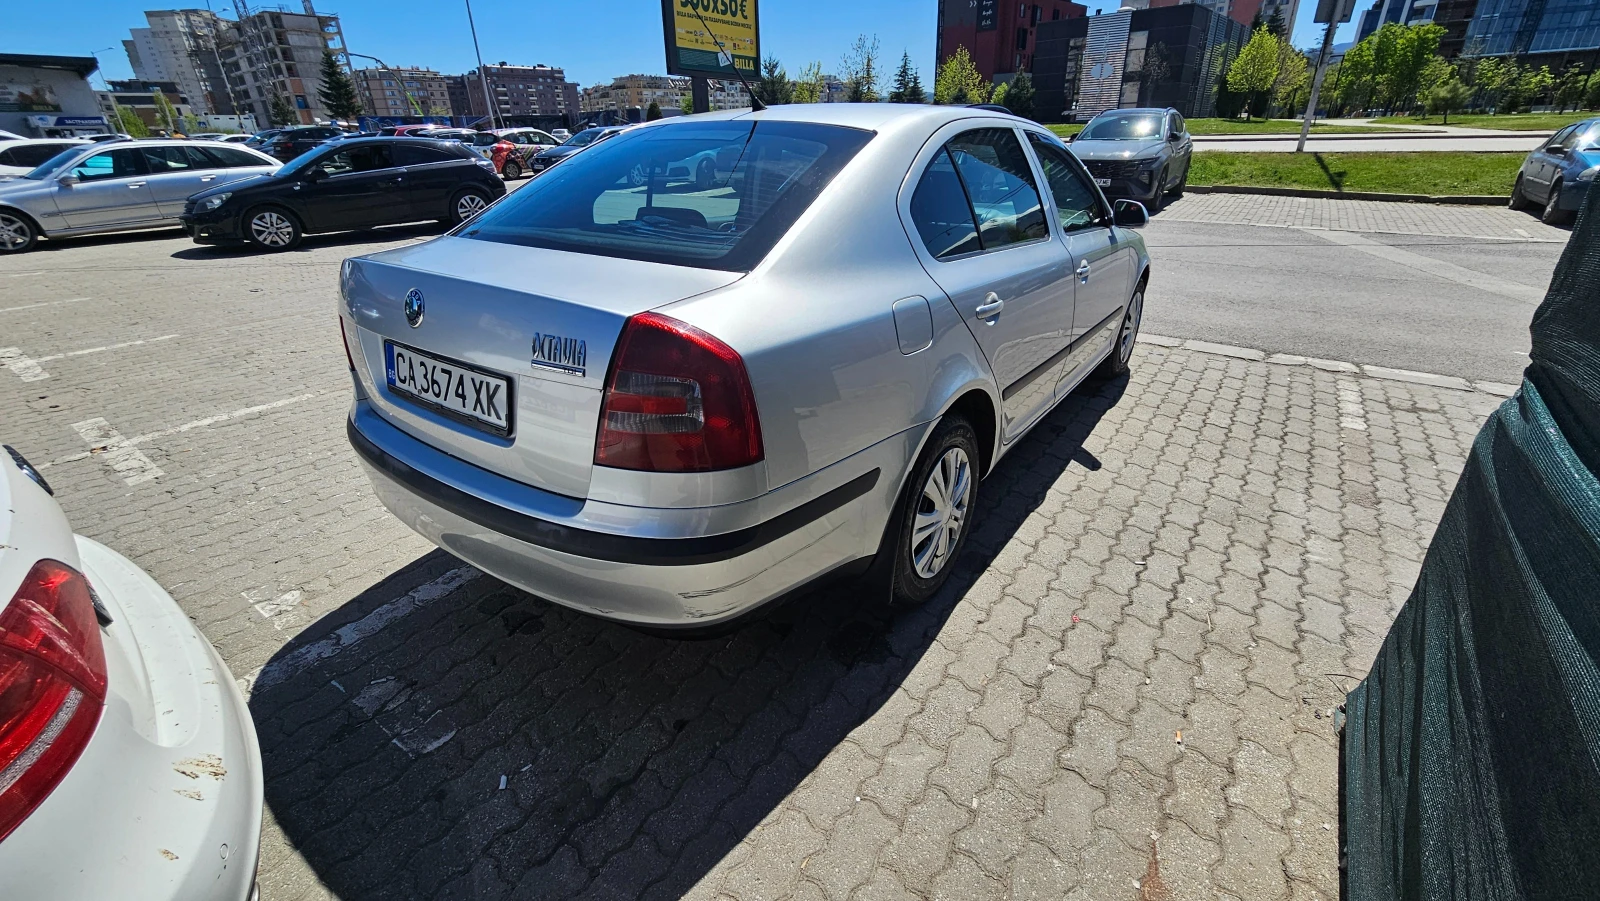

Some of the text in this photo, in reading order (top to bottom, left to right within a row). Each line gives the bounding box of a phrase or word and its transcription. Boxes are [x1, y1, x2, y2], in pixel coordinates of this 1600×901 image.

[734, 58, 754, 71] BILLA
[531, 332, 586, 367] OCTAVIA
[388, 368, 396, 380] BG
